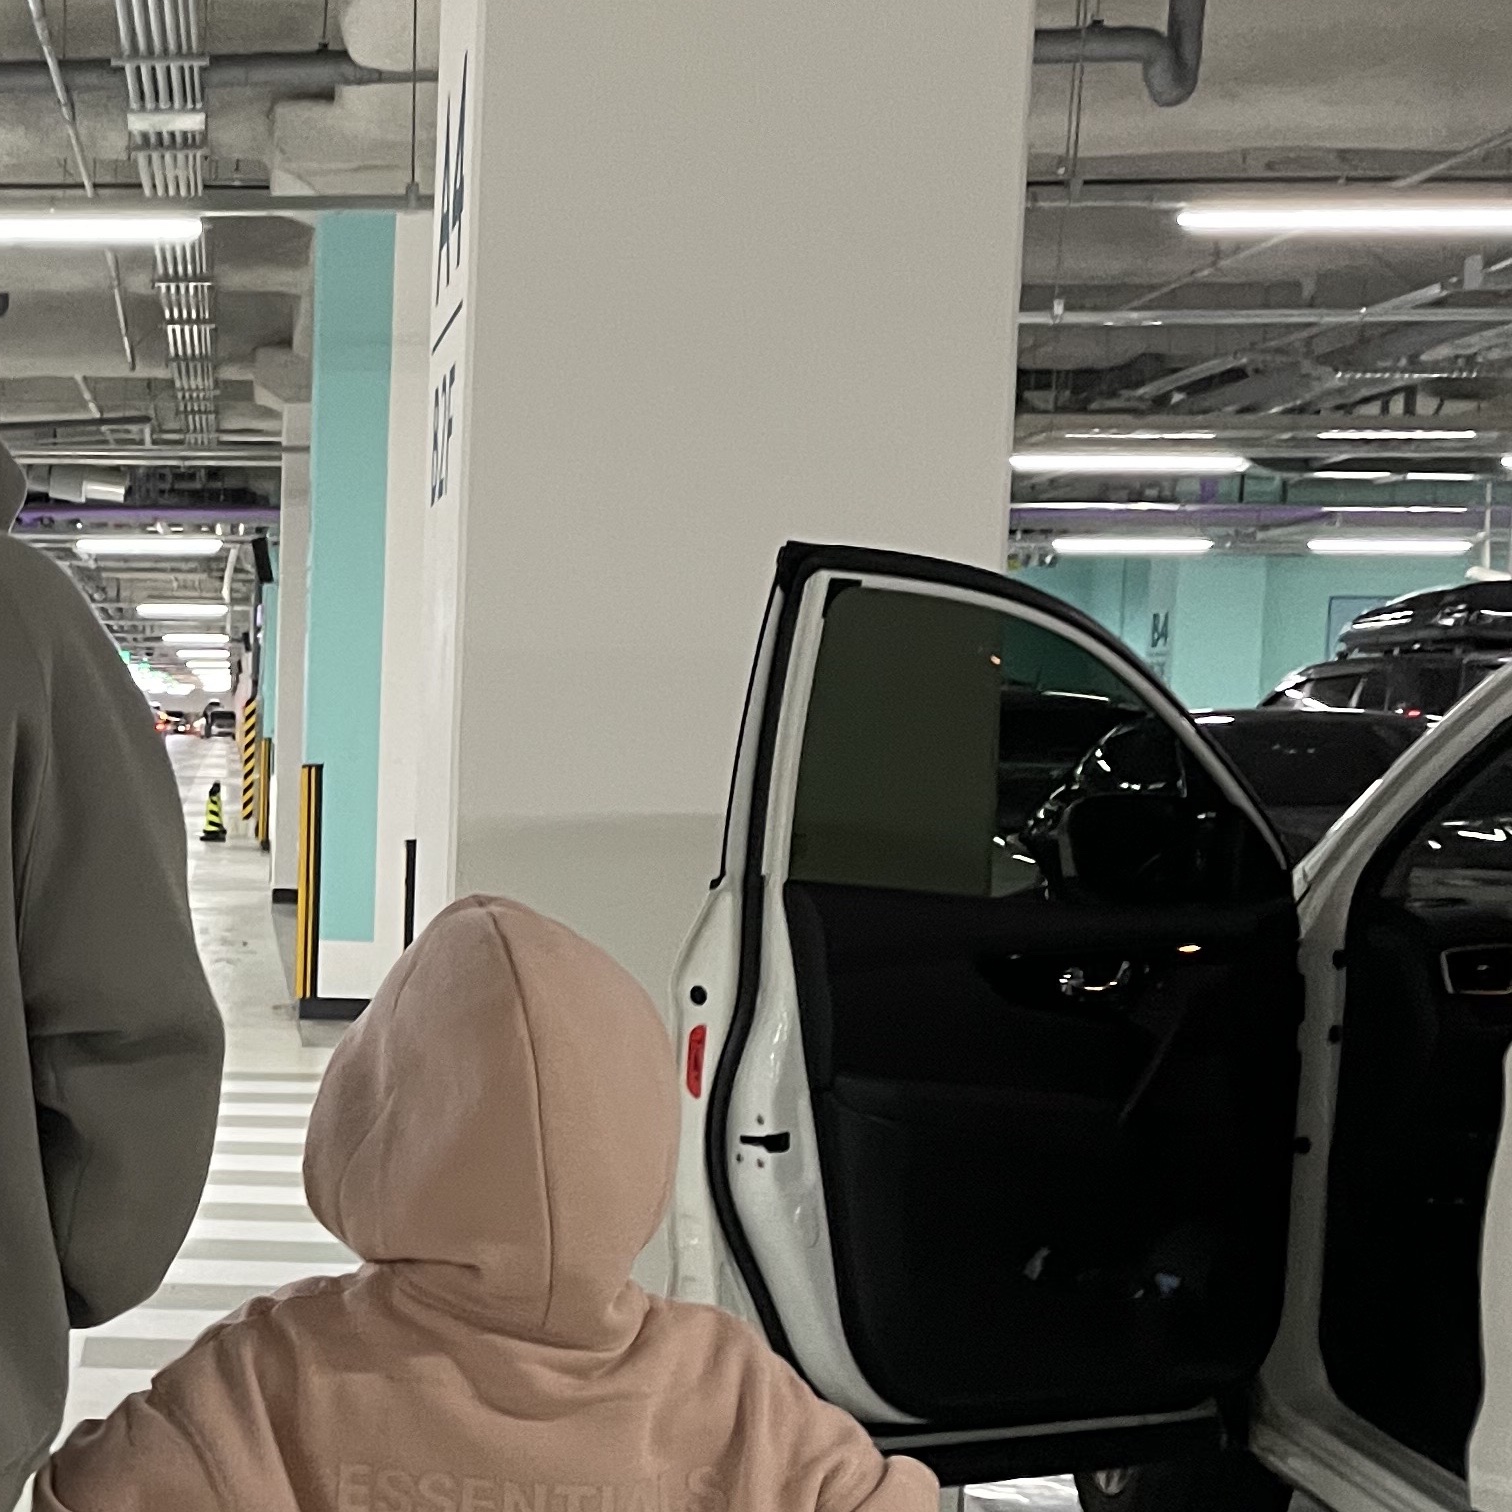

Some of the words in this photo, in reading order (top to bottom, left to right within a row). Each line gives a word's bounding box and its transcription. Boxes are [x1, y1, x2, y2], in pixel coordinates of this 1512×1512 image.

[436, 49, 469, 306] A4
[430, 362, 456, 506] B2F
[1151, 611, 1169, 648] B4
